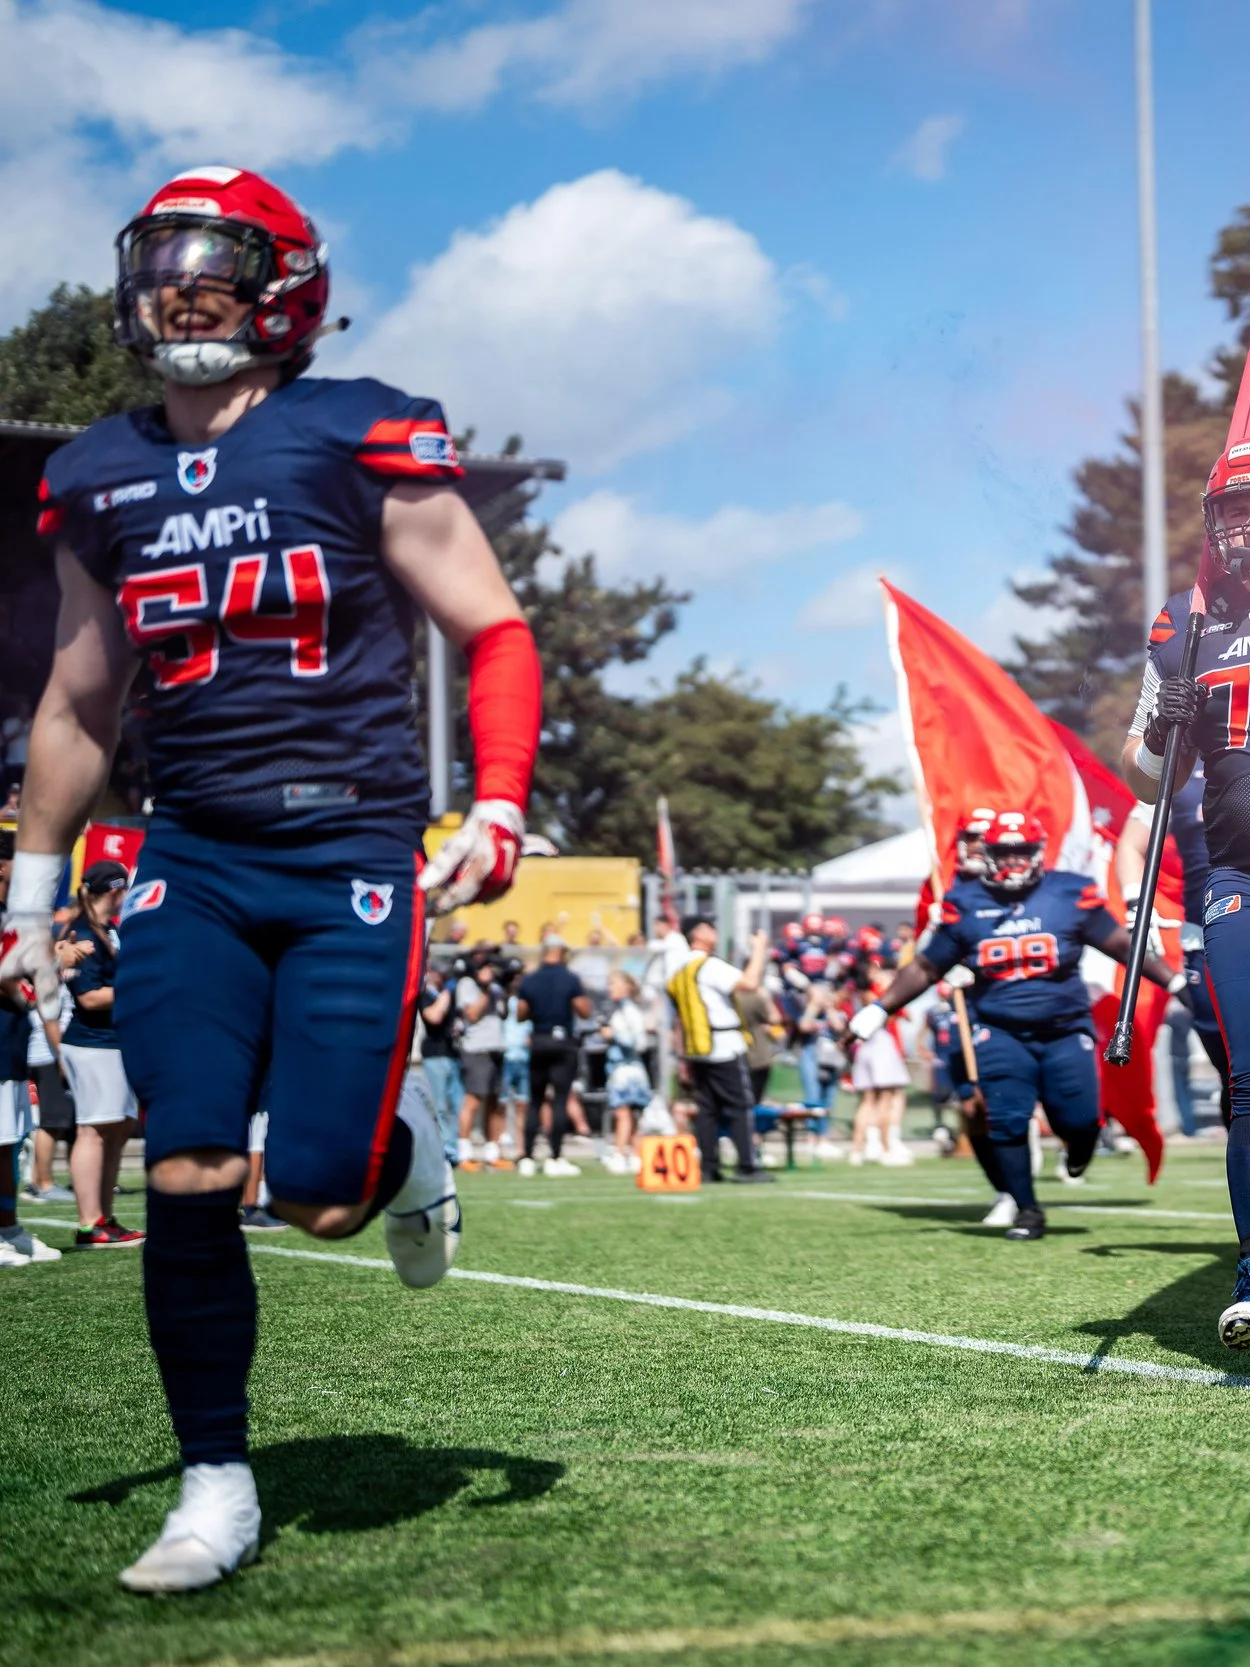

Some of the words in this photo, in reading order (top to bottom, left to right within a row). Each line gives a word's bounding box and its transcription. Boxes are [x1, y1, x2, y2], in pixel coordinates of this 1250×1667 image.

[141, 497, 271, 560] AMPri
[117, 543, 331, 690] 54
[652, 1143, 691, 1182] 40
